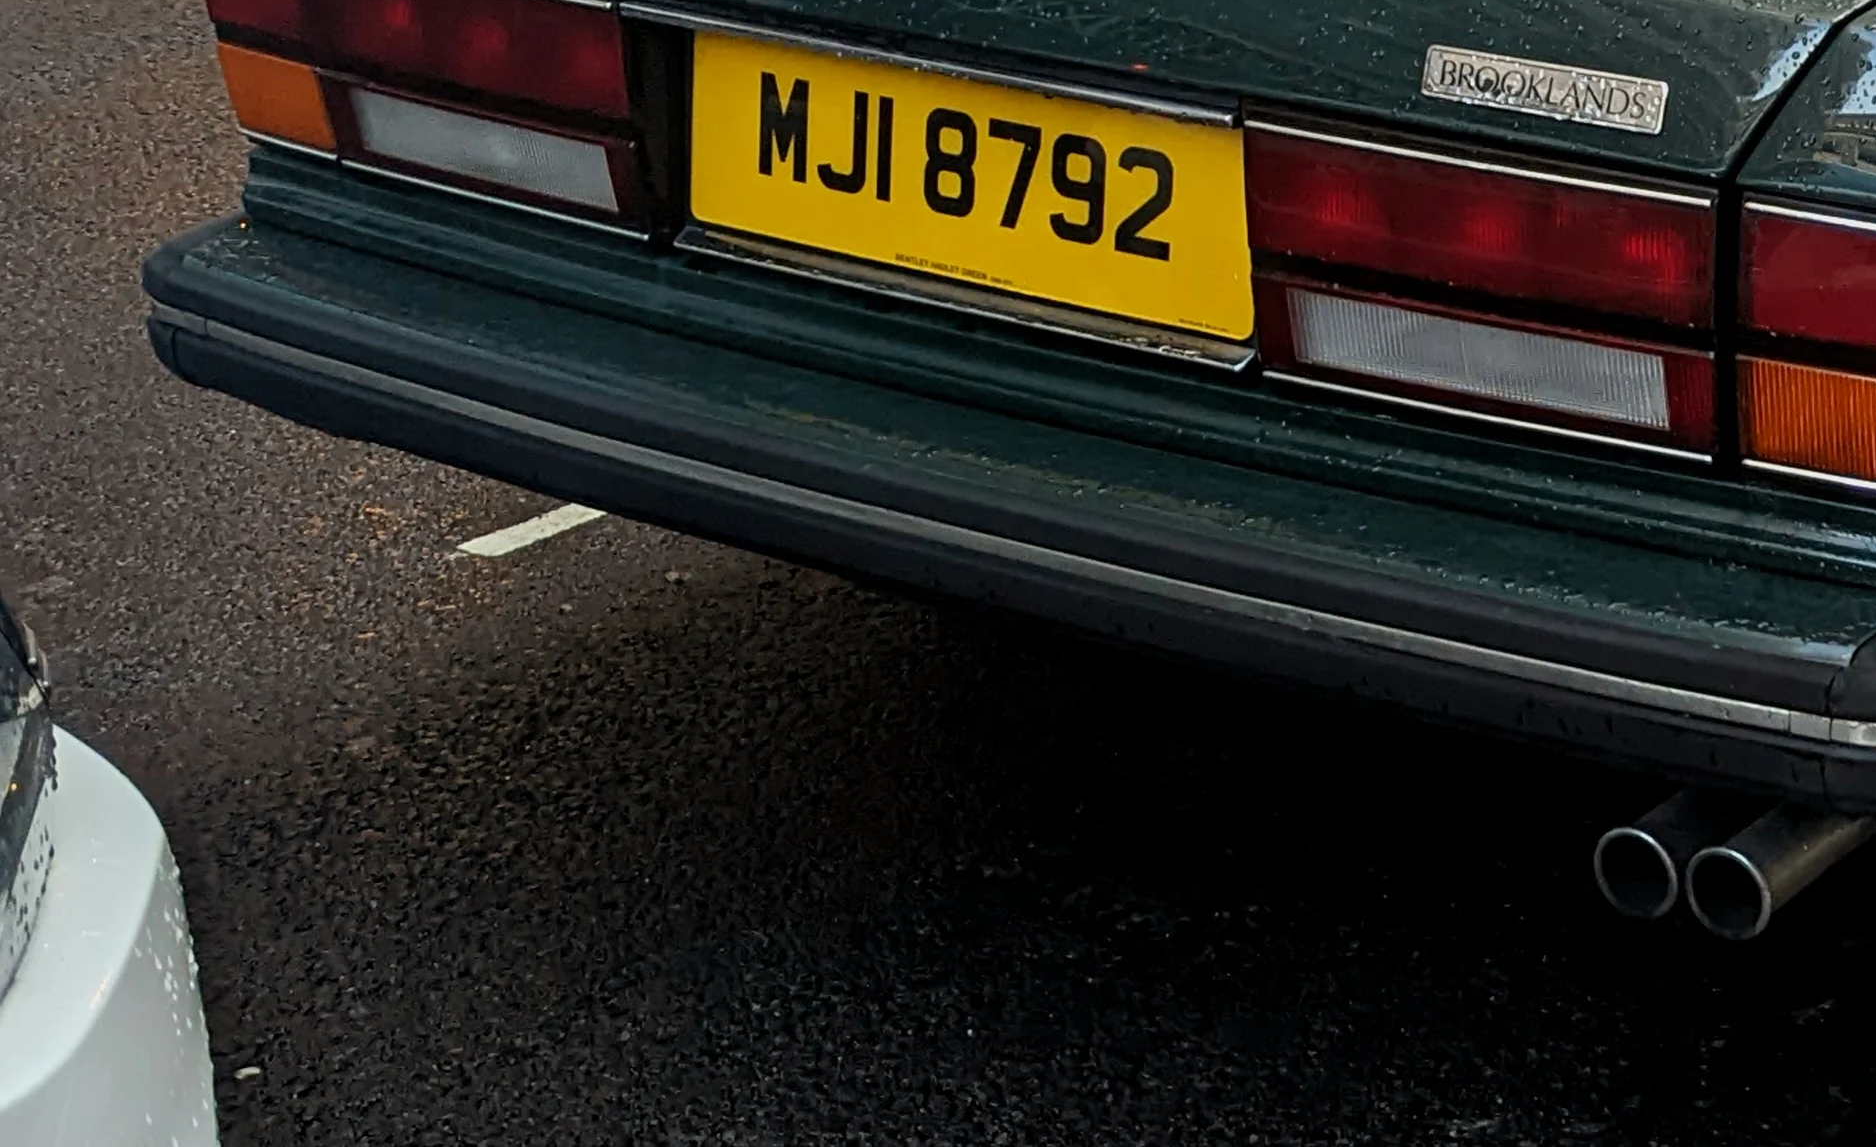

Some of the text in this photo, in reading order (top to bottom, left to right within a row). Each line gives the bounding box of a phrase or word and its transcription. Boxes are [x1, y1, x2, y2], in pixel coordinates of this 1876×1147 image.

[1440, 59, 1646, 119] BROOKLANDS
[758, 71, 1174, 262] MJI 8792
